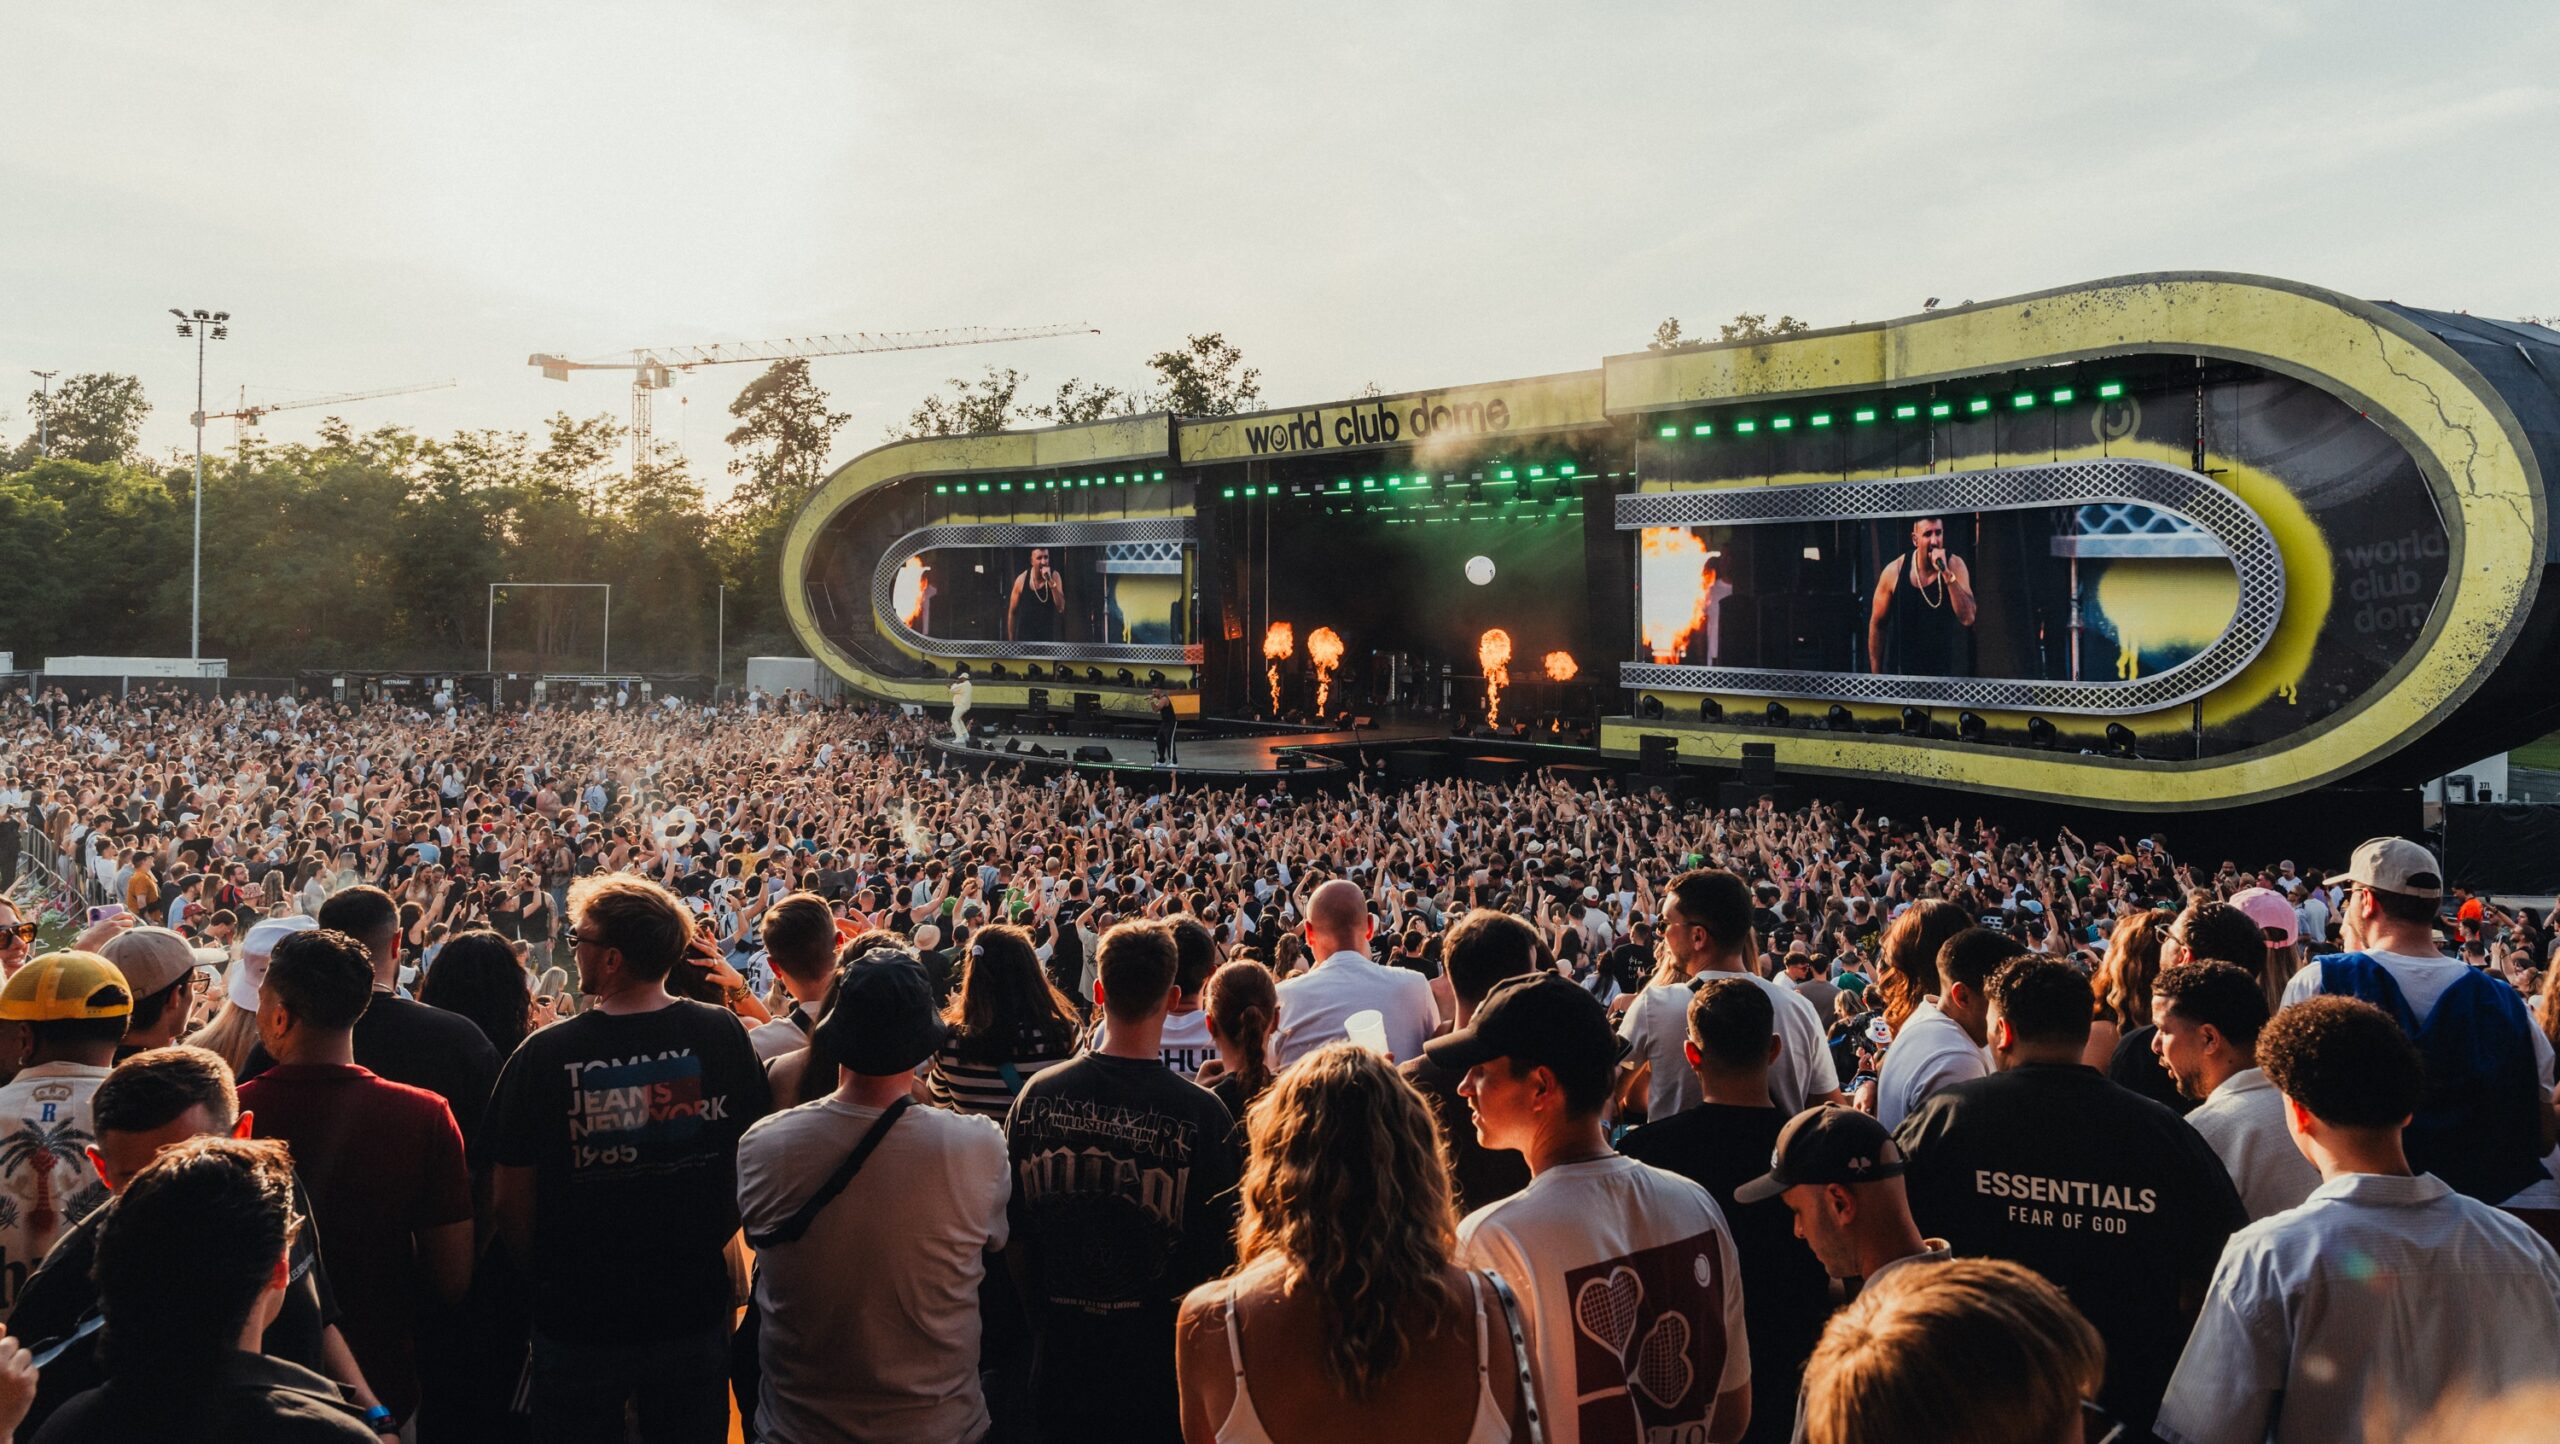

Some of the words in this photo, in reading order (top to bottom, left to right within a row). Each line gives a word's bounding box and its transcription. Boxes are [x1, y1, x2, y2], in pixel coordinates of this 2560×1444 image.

[1245, 410, 1323, 454] world
[1335, 402, 1400, 446] club
[1410, 398, 1511, 439] dome
[2345, 527, 2446, 569] world
[2350, 565, 2421, 601] club
[2354, 602, 2430, 634] dom
[41, 1103, 56, 1122] R
[567, 1082, 673, 1115] JEANS
[572, 1145, 638, 1168] 1985
[1976, 1169, 2157, 1213] ESSENTIALS
[2008, 1206, 2053, 1227] FEAR
[2062, 1212, 2083, 1230] OF
[2092, 1216, 2127, 1235] GOD
